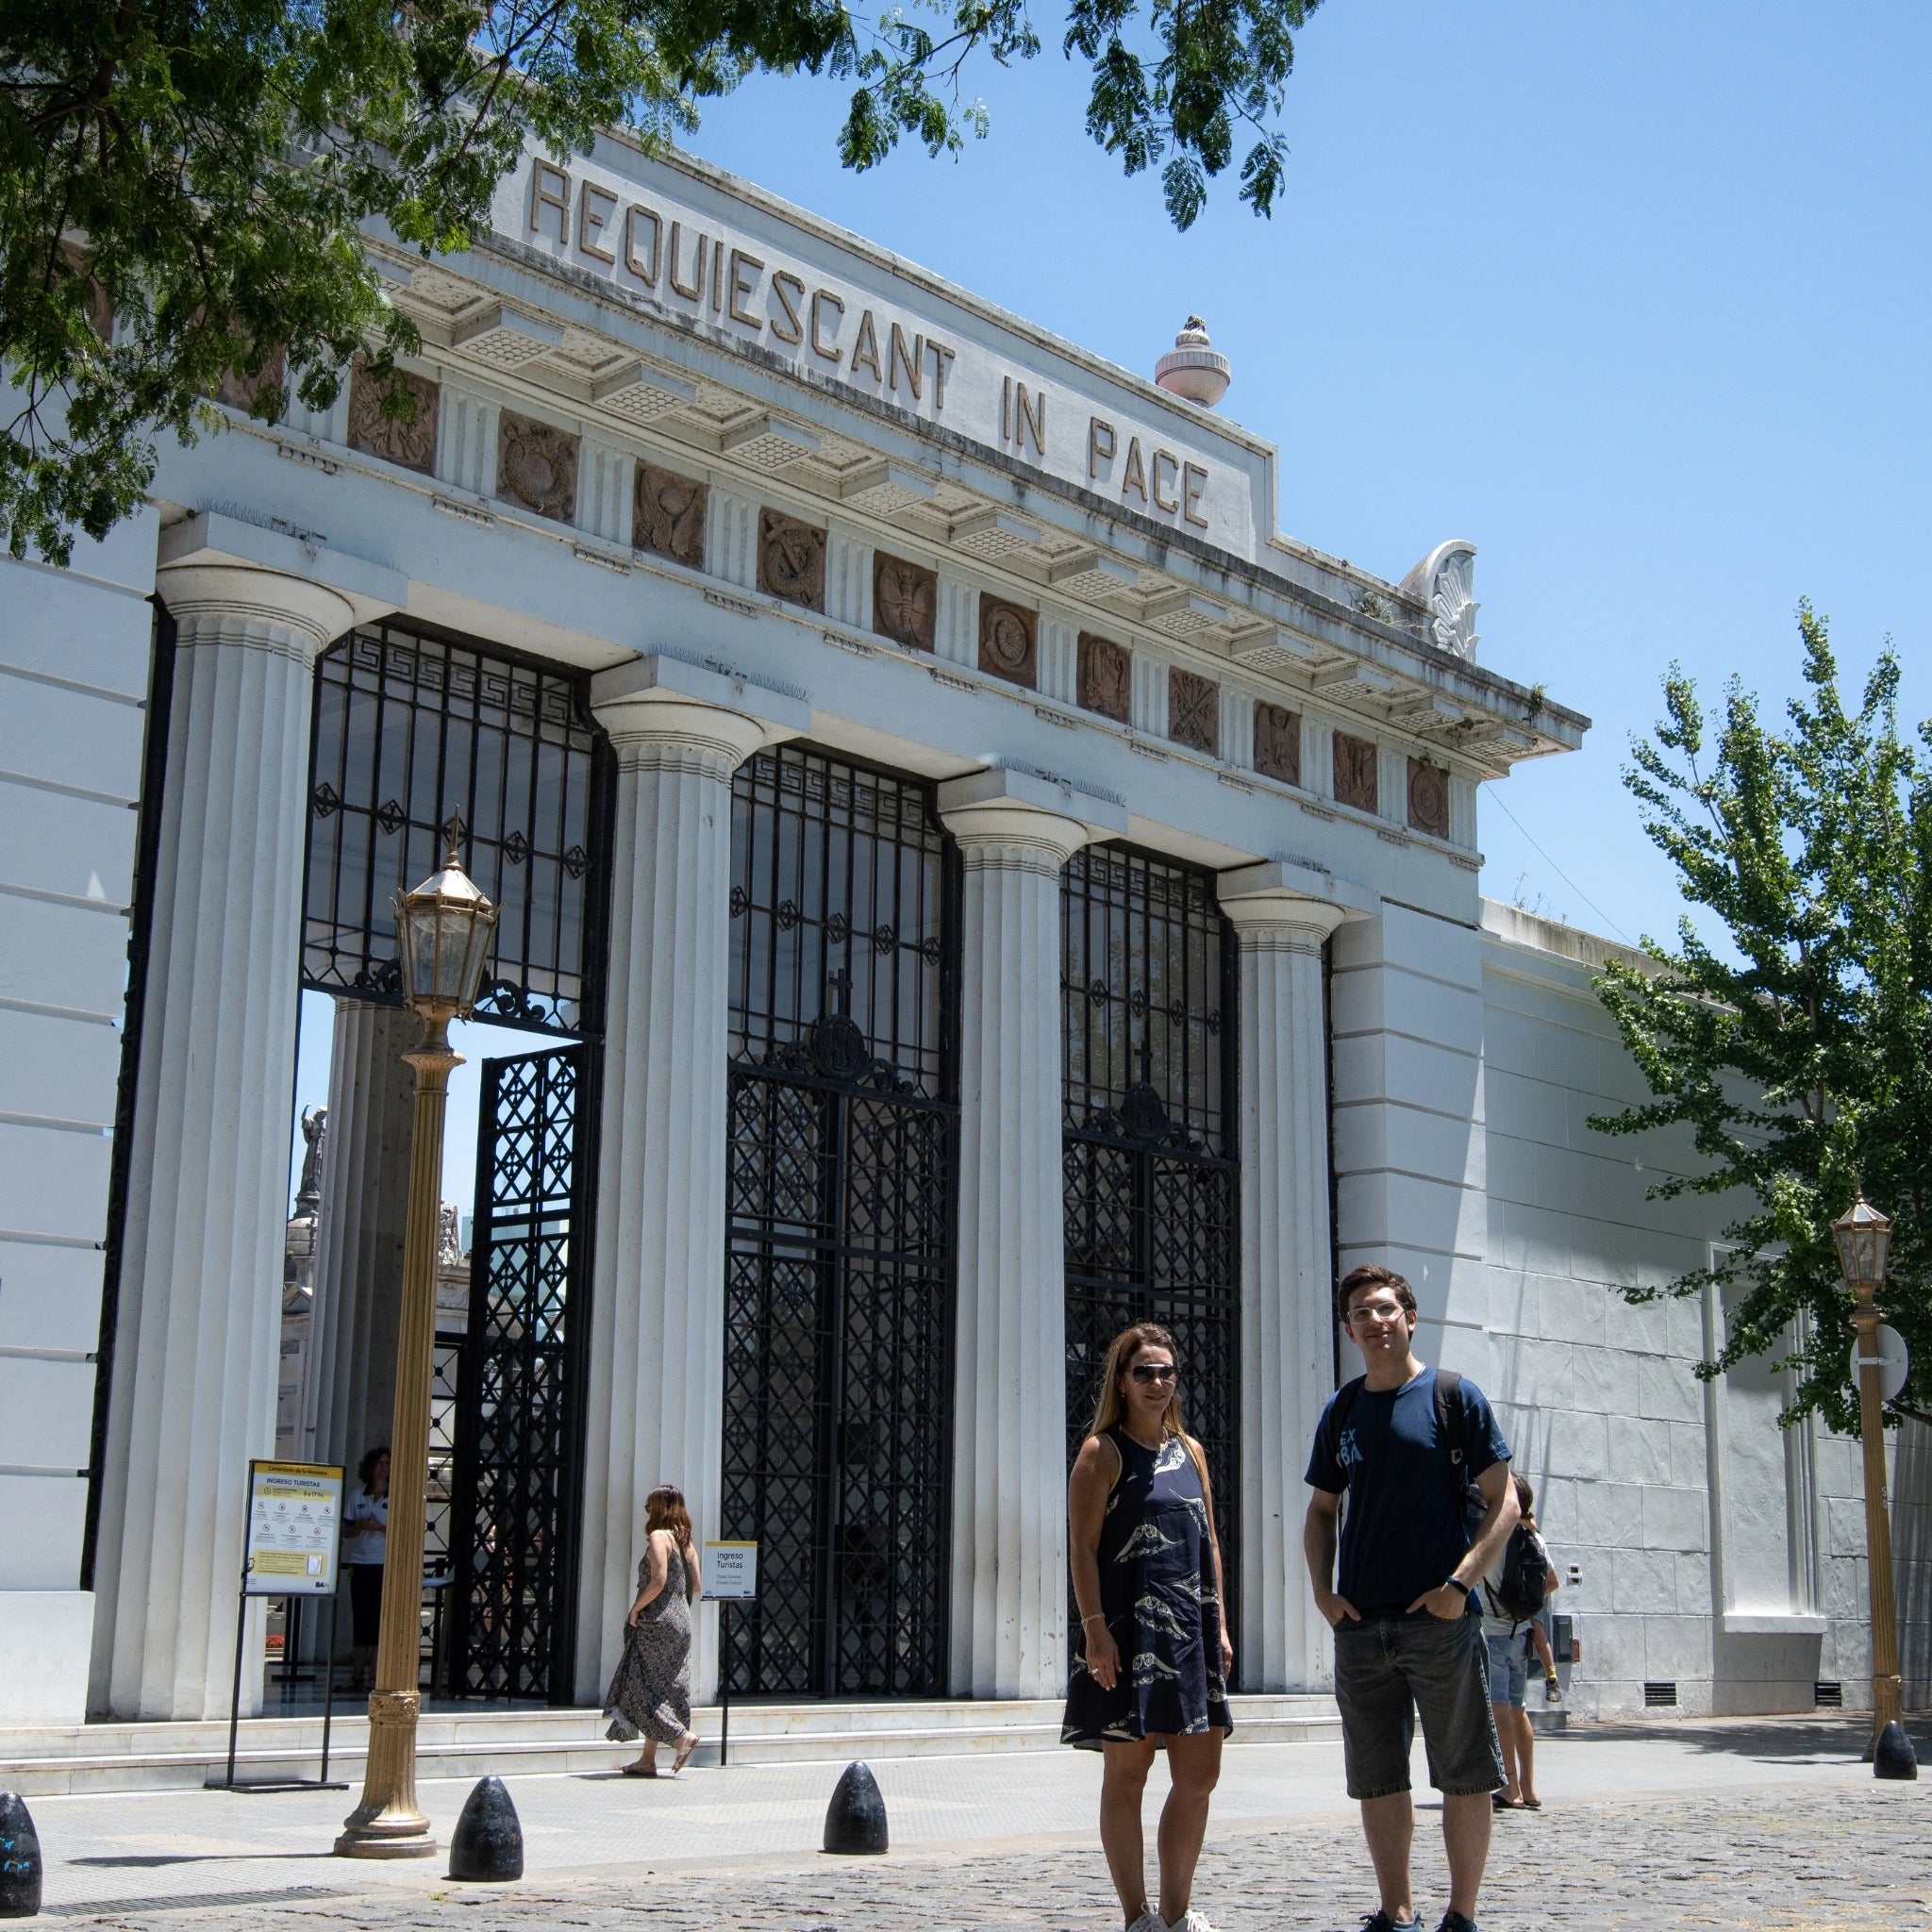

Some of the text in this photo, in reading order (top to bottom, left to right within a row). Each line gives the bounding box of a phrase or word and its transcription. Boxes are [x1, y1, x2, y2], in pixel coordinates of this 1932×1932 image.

[530, 157, 1210, 529] REQUIESCANT IN PACE
[266, 1477, 321, 1488] INGRESO TURISTAS
[717, 1551, 743, 1560] Ingreso
[717, 1560, 743, 1569] Turistas
